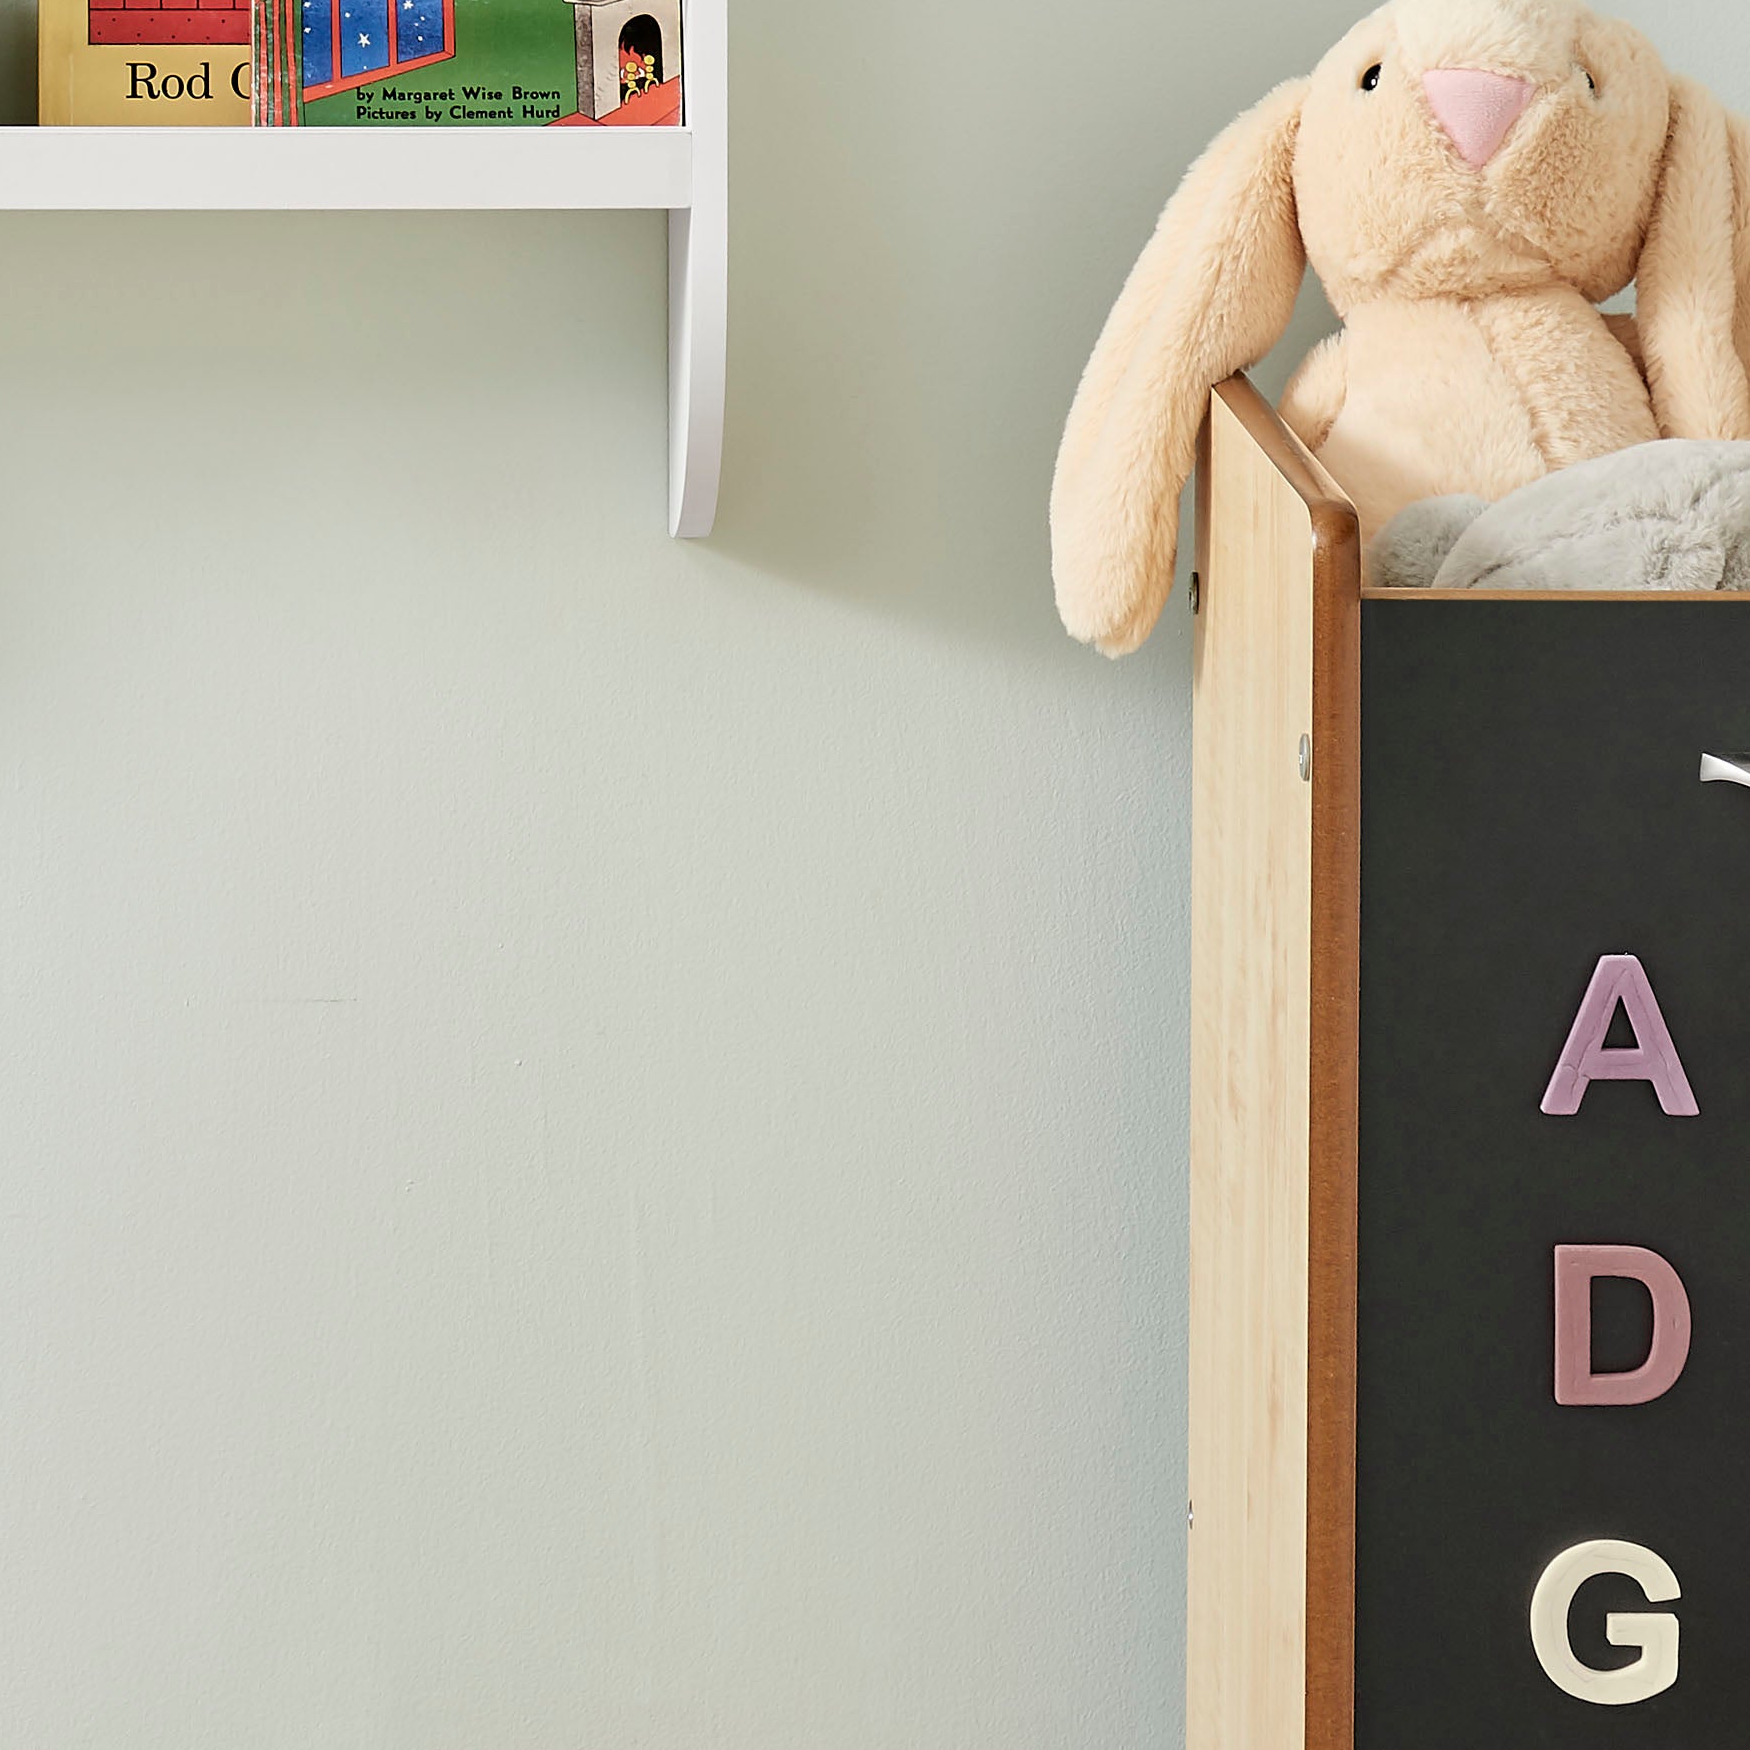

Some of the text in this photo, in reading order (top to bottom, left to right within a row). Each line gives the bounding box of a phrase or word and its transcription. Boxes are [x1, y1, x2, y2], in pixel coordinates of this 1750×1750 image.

[125, 61, 212, 100] Rod
[356, 86, 561, 104] by Margaret Wise Brown
[356, 104, 560, 123] Pictures by Clement Hurd
[1539, 953, 1700, 1117] A
[1553, 1243, 1693, 1407] D
[1529, 1538, 1683, 1705] G
